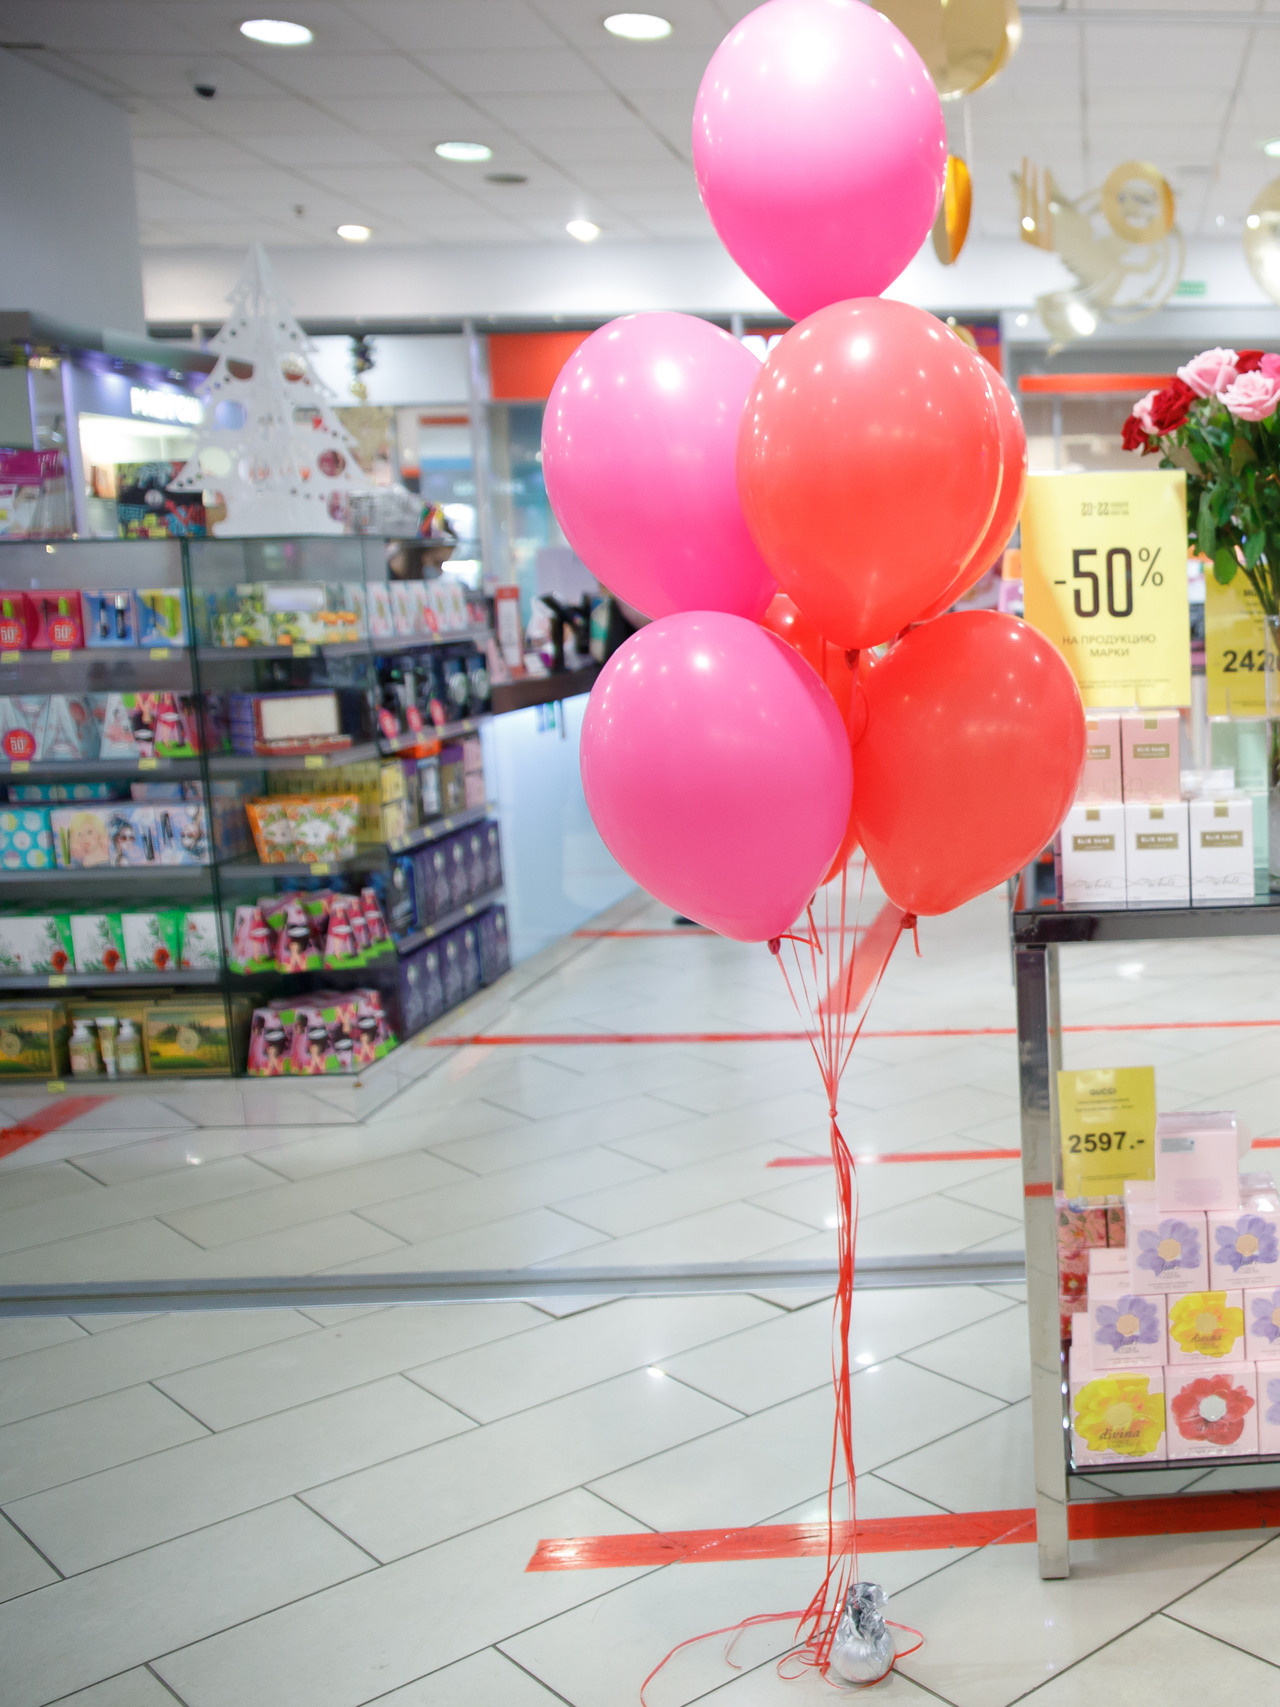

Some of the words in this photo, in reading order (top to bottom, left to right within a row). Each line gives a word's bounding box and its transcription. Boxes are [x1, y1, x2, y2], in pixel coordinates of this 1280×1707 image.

[1054, 547, 1164, 617] -50%
[1062, 635, 1078, 645] НА
[1081, 633, 1156, 646] ПРОДУКЦИЮ
[1090, 648, 1130, 657] МАРКИ
[1068, 1131, 1145, 1154] 2597.-
[1100, 1427, 1141, 1440] divina
